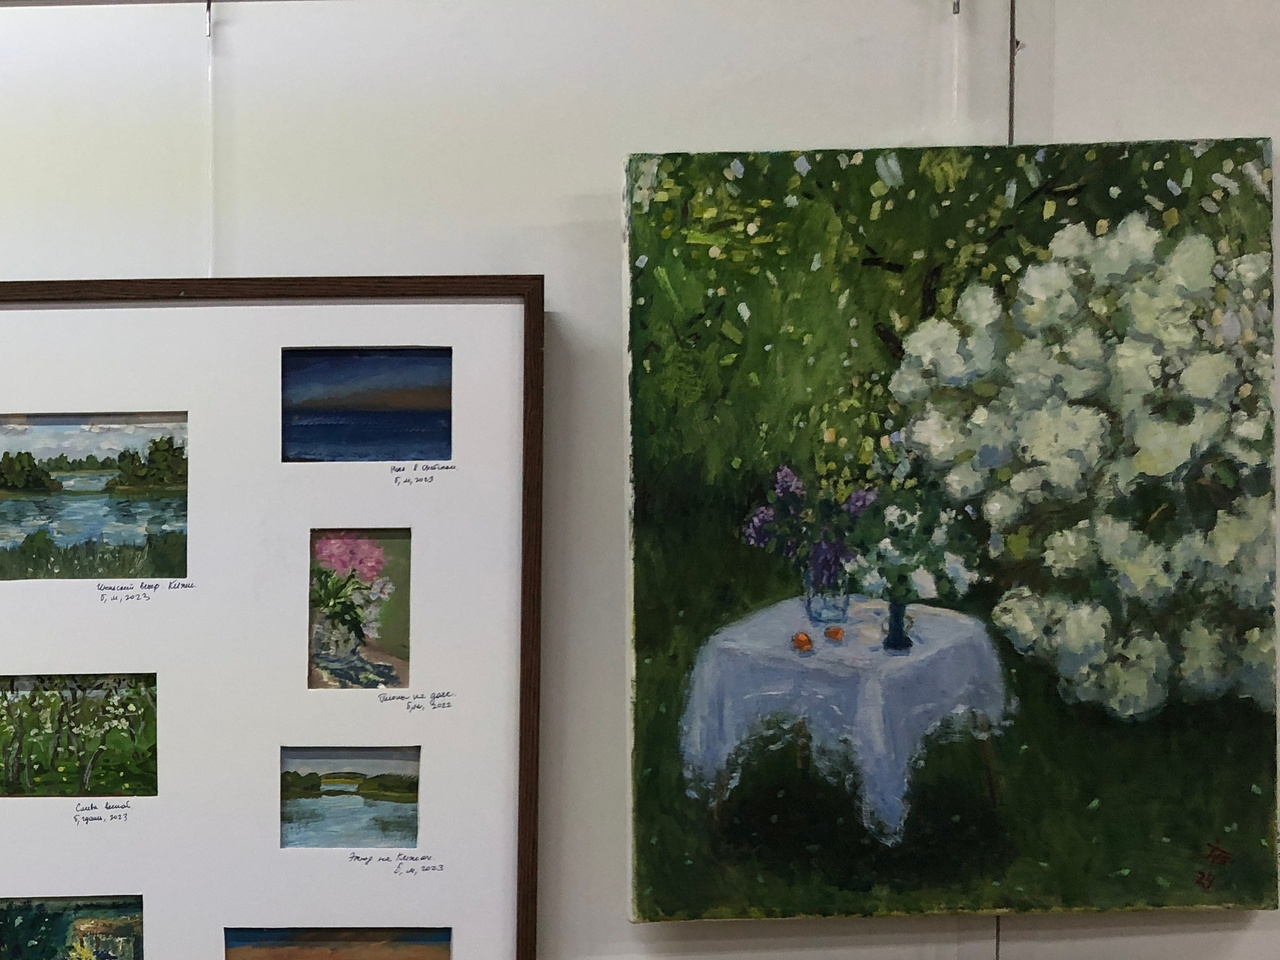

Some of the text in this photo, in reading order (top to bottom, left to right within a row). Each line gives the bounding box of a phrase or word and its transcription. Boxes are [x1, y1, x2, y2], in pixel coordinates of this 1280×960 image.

[415, 475, 434, 483] 2023
[125, 592, 151, 602] 2023
[109, 813, 128, 822] 2023
[421, 864, 444, 872] 2023
